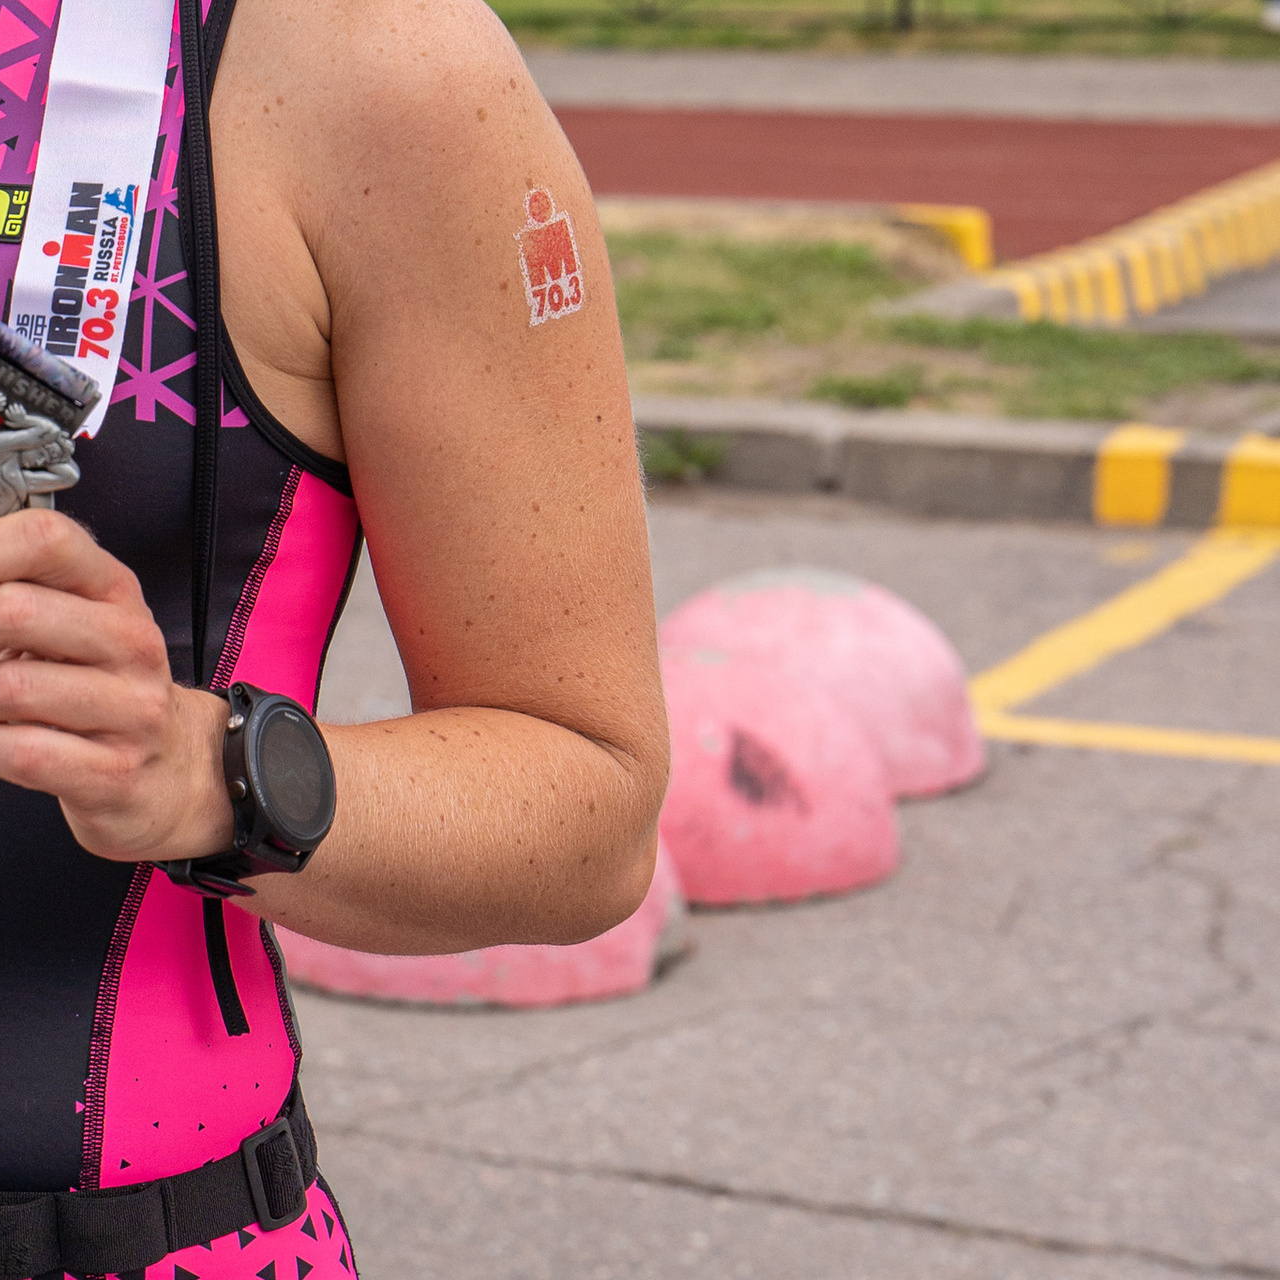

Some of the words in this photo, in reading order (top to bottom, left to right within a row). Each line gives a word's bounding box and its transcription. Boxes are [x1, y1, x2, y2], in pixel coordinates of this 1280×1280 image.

[43, 181, 104, 357] IRONMAN
[93, 216, 119, 282] RUSSIA
[112, 216, 129, 271] PETERSBURG
[77, 287, 119, 360] 70.3
[532, 275, 582, 318] 70.3
